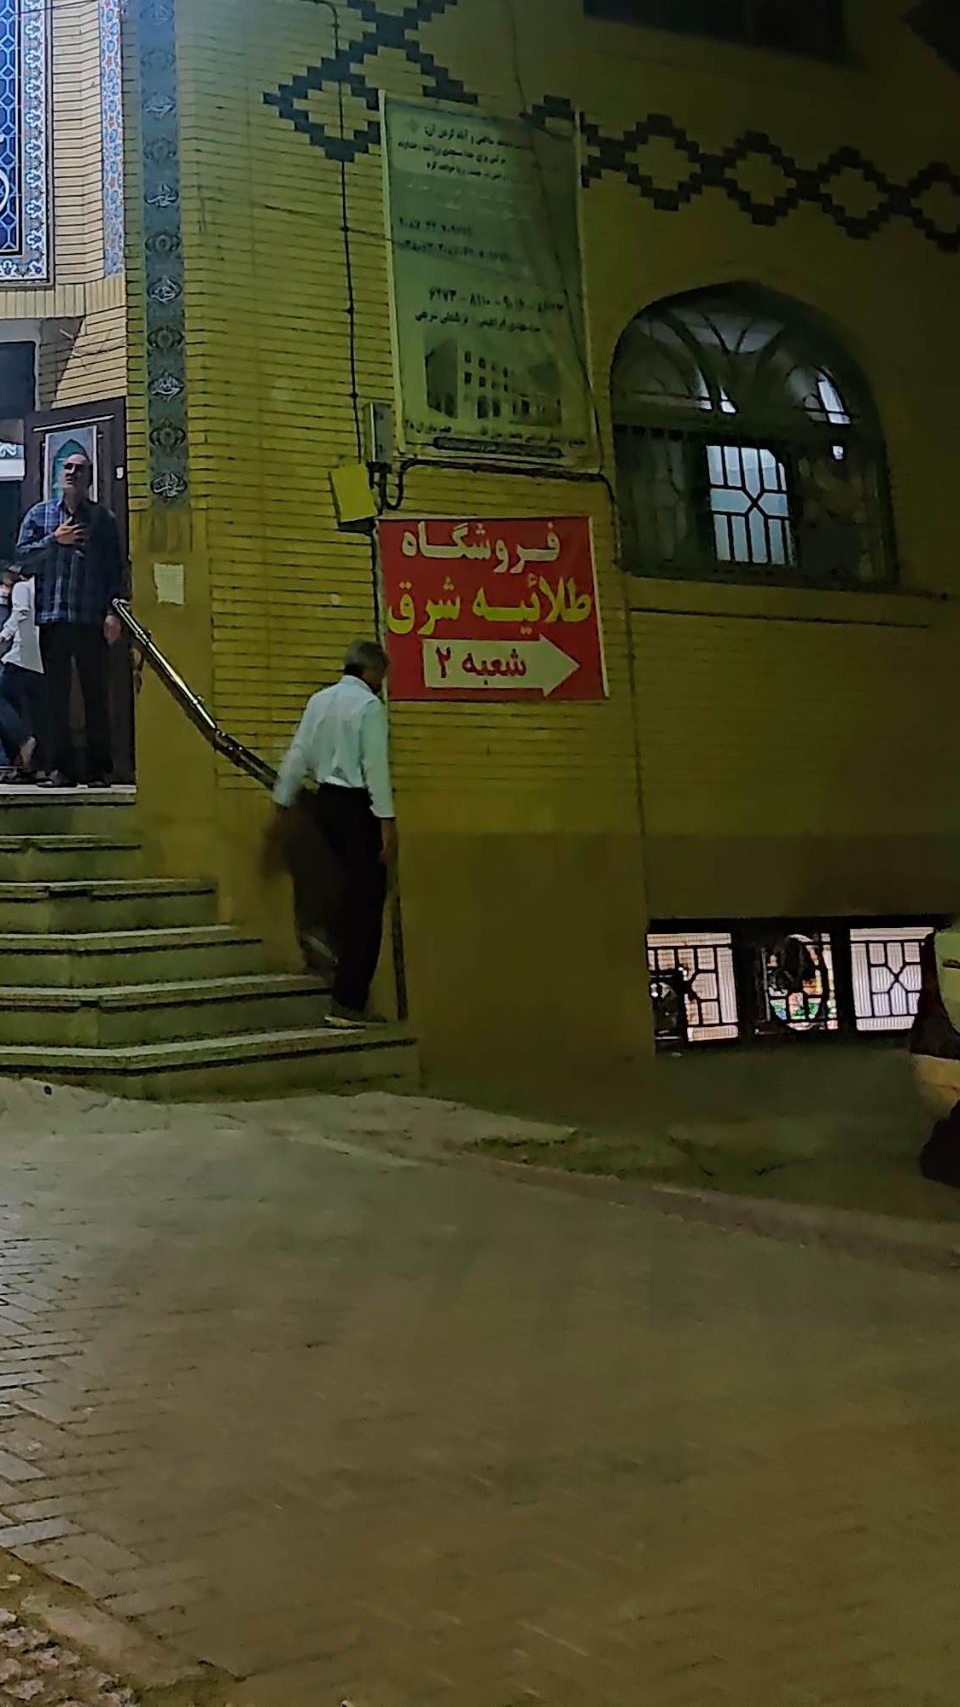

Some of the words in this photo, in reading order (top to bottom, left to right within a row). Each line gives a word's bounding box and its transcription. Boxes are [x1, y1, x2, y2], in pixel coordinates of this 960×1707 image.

[402, 521, 561, 574] فروشگاه
[388, 576, 462, 635] شرق
[472, 573, 592, 635] طلائیه
[435, 646, 452, 679] ۲
[461, 648, 528, 686] شعبه
